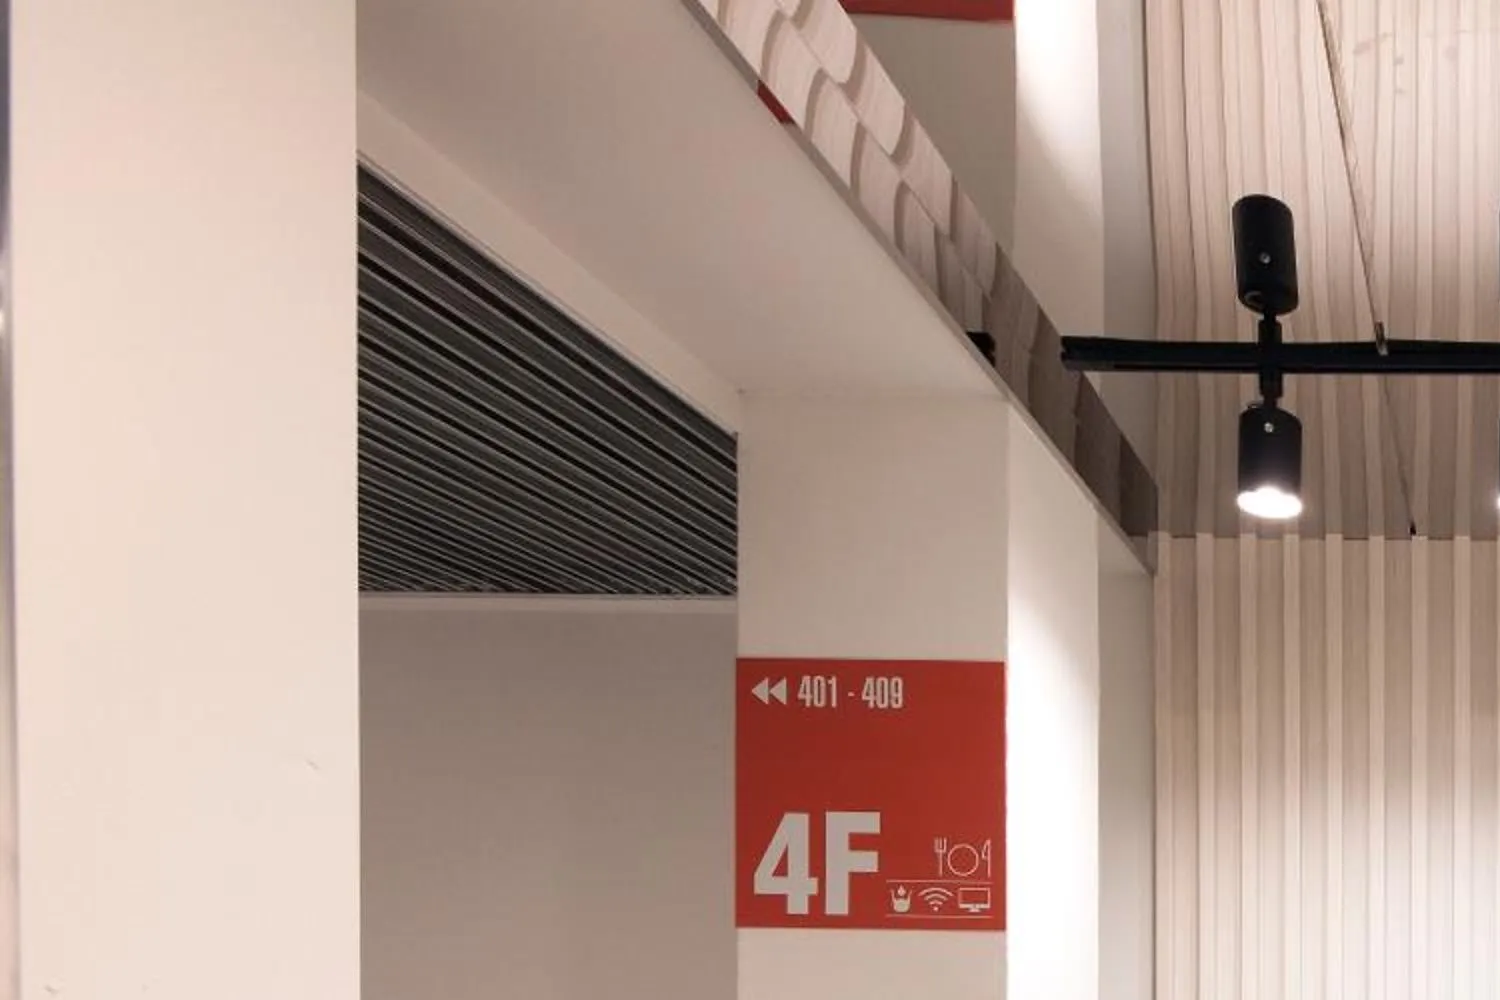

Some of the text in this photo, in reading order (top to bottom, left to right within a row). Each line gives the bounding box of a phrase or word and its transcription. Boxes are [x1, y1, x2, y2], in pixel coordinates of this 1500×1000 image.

[797, 675, 837, 708] 401
[861, 676, 903, 709] 409
[754, 811, 881, 915] 4F
